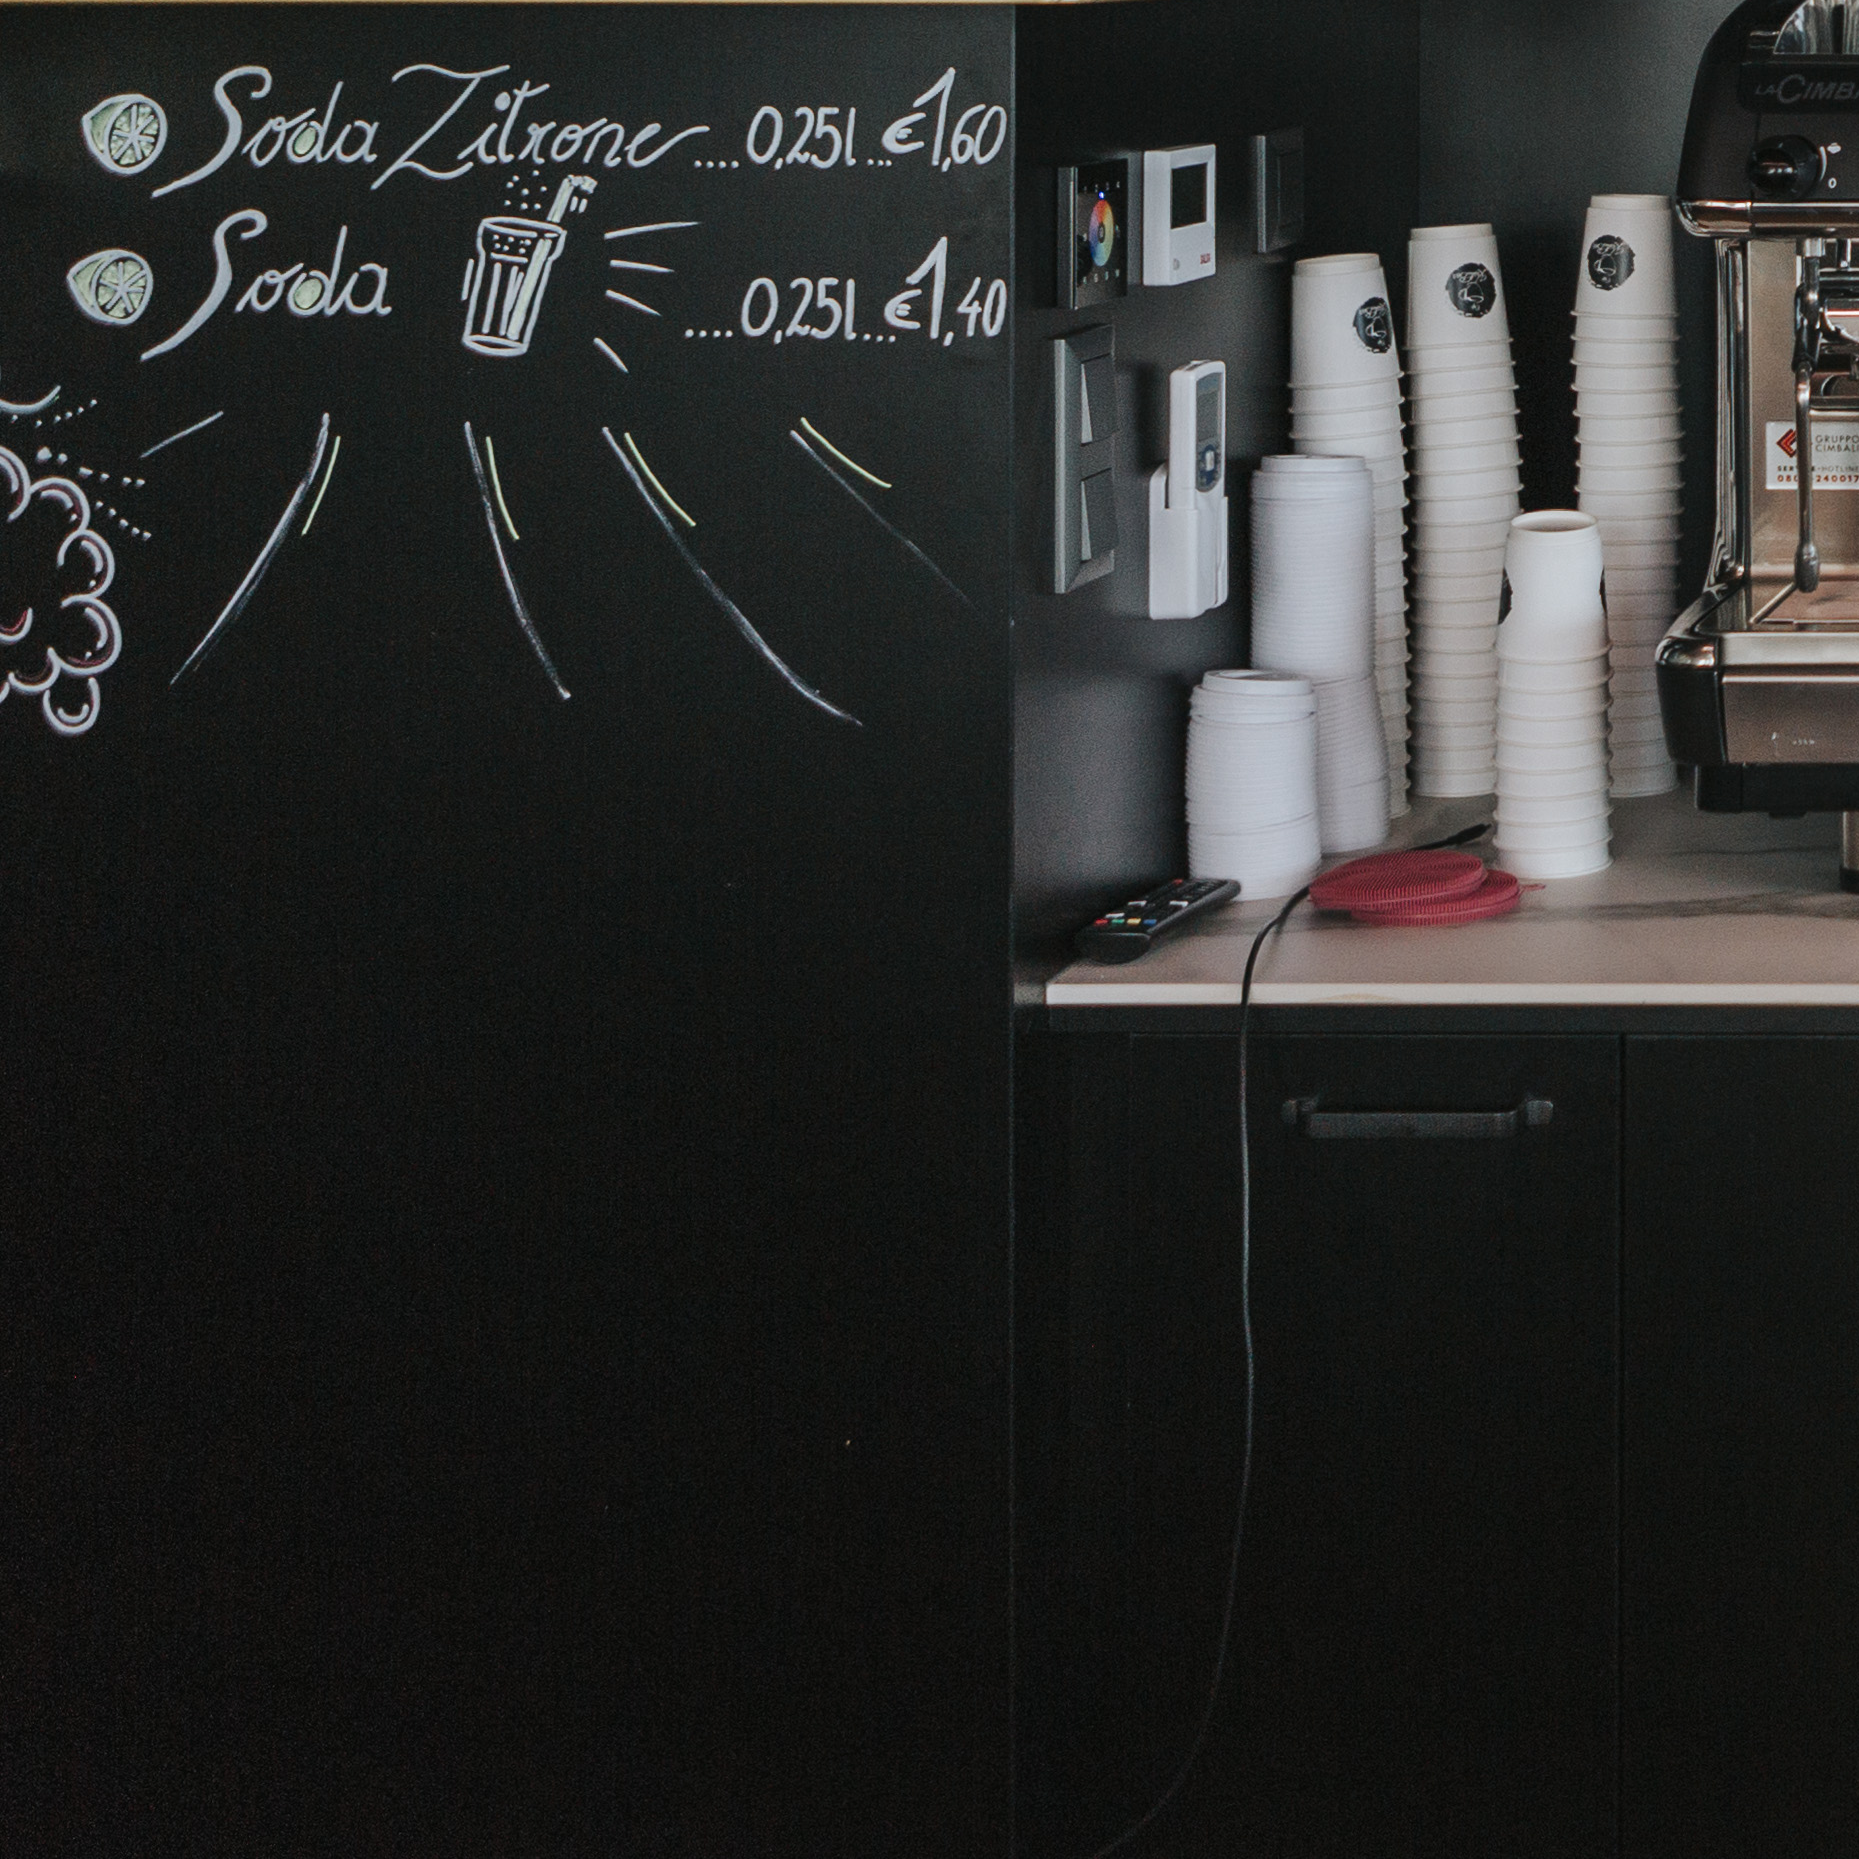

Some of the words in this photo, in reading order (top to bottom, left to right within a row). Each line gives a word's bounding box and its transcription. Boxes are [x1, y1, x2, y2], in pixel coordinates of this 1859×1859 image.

[151, 65, 380, 198] Soda
[370, 63, 710, 190] Zitrone
[141, 208, 393, 362] Soda
[1815, 444, 1859, 452] CIMBALI
